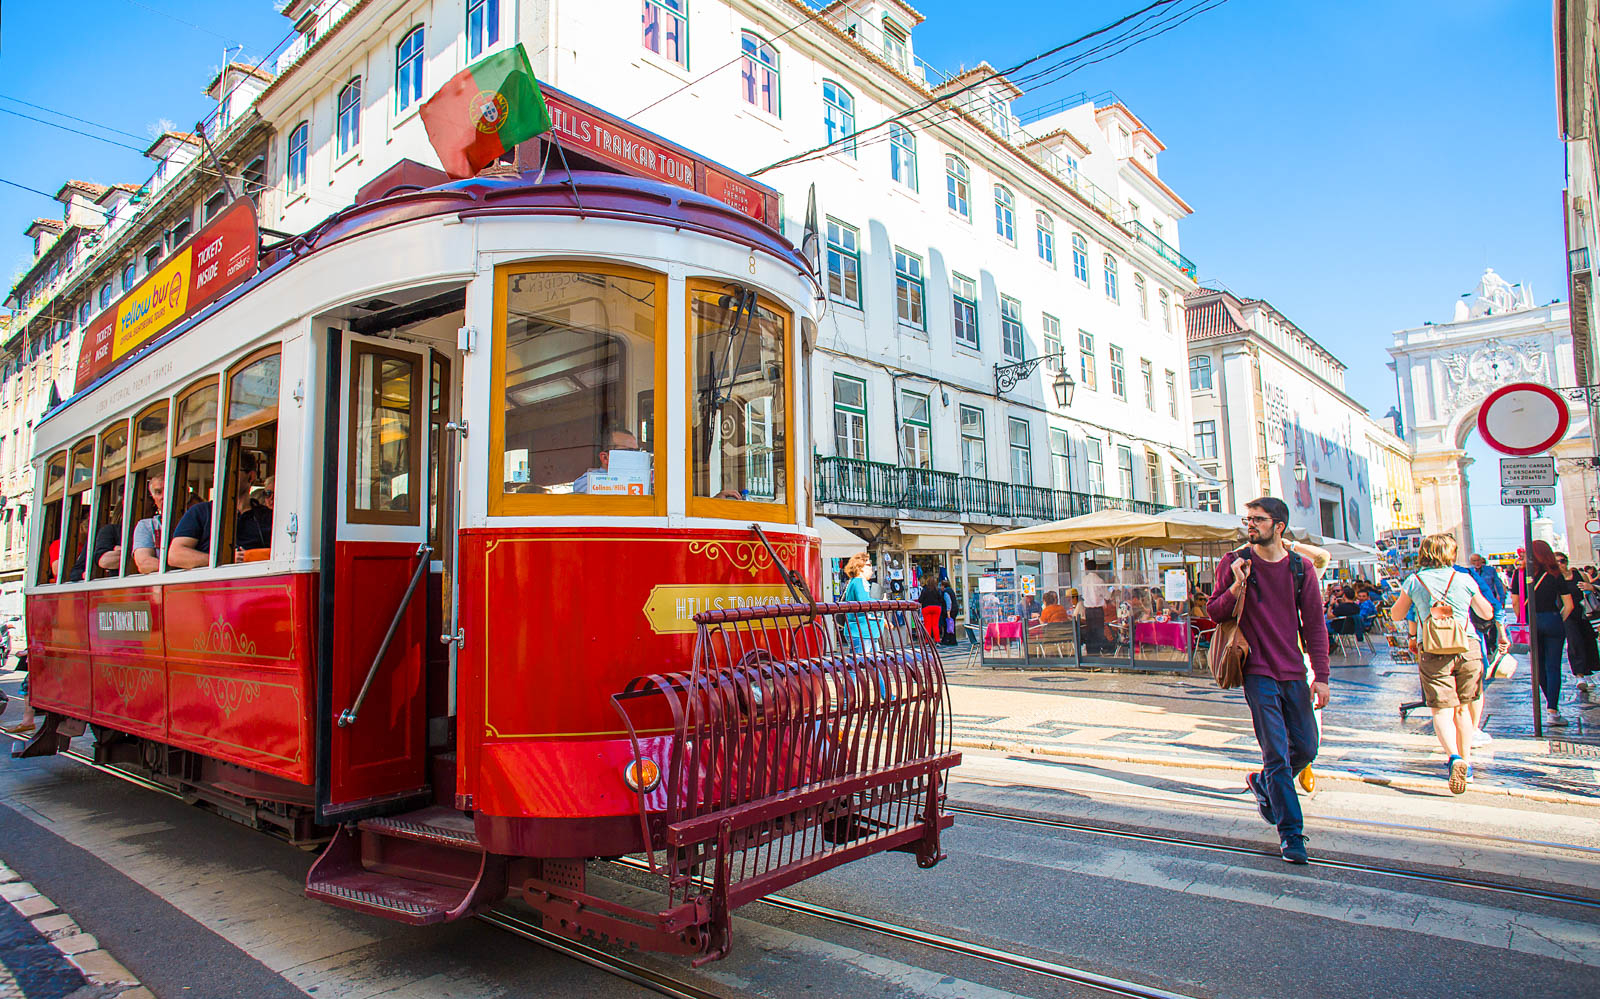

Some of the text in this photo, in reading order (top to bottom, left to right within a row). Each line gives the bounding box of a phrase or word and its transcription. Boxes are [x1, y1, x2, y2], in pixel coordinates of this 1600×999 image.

[593, 125, 656, 171] TRAMCAR
[658, 153, 693, 187] TOUR
[197, 235, 223, 268] TICKETS
[196, 261, 219, 290] INSIDE
[748, 256, 756, 275] 8
[96, 322, 113, 346] TICKETS
[631, 485, 641, 496] 3
[134, 610, 150, 632] TOUR
